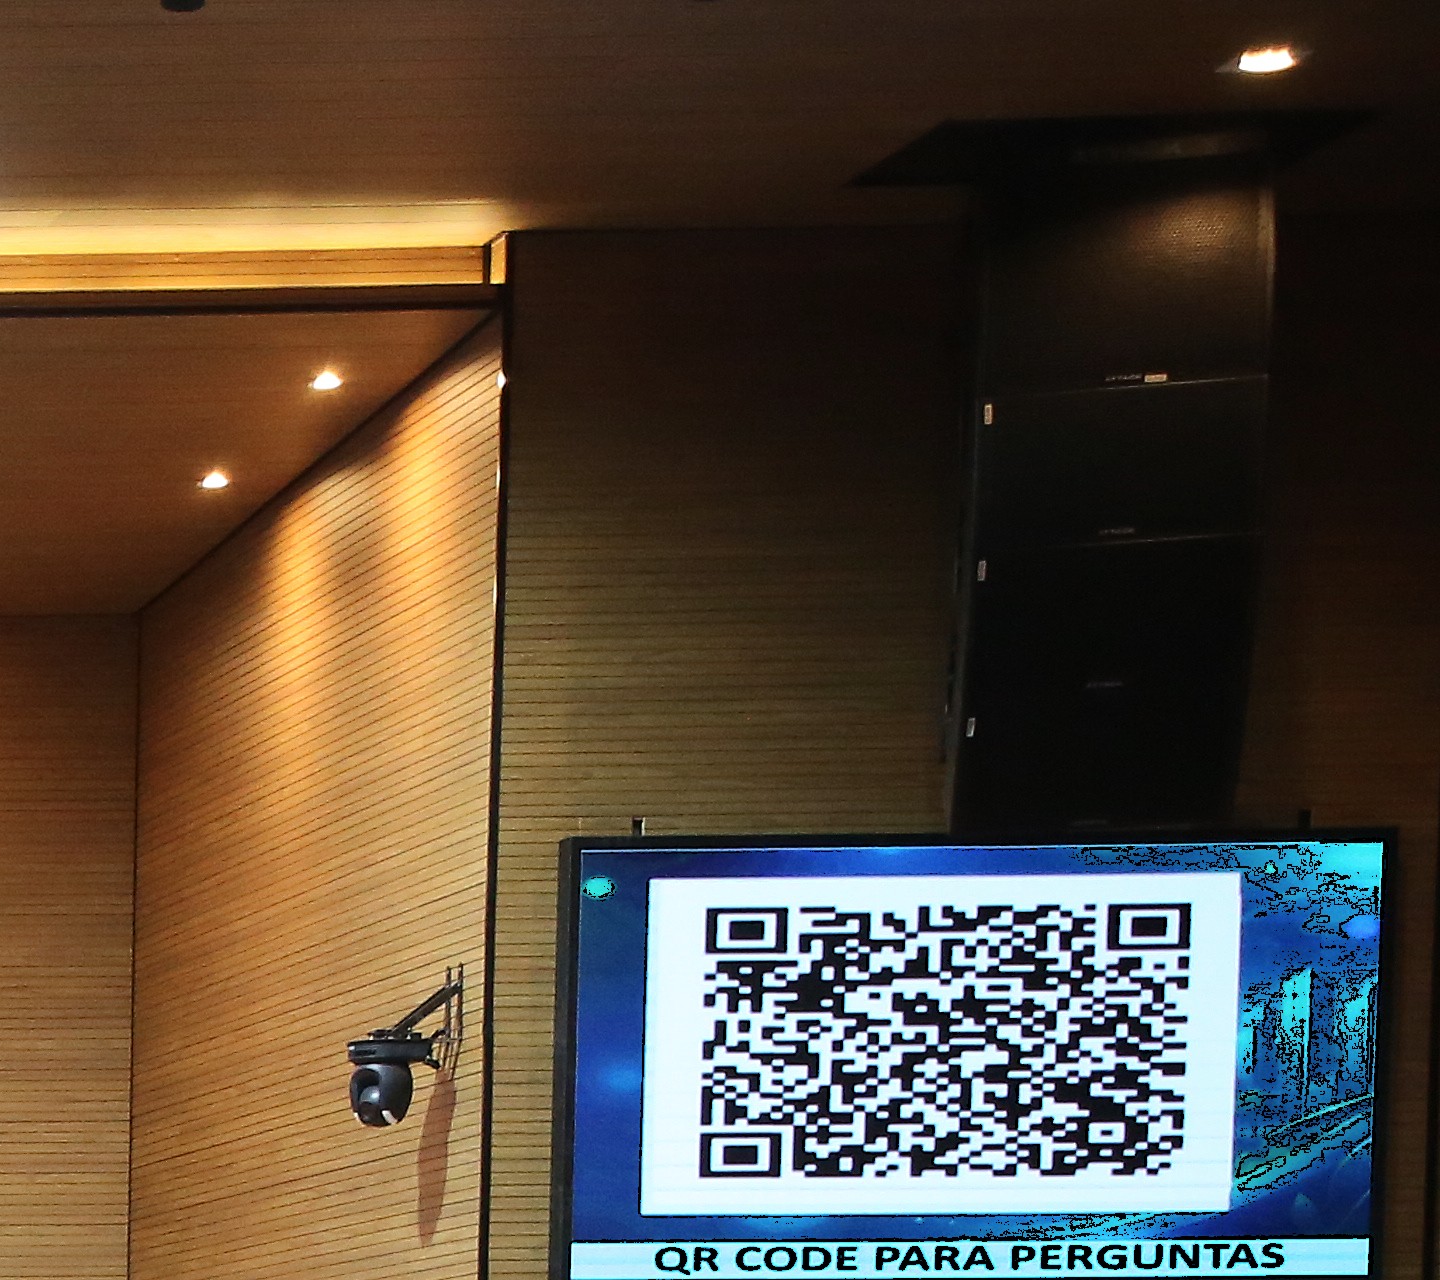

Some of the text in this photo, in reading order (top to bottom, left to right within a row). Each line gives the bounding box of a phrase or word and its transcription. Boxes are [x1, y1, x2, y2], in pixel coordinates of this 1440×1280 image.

[655, 1242, 1284, 1274] QR CODE PARA PERGUNTAS
